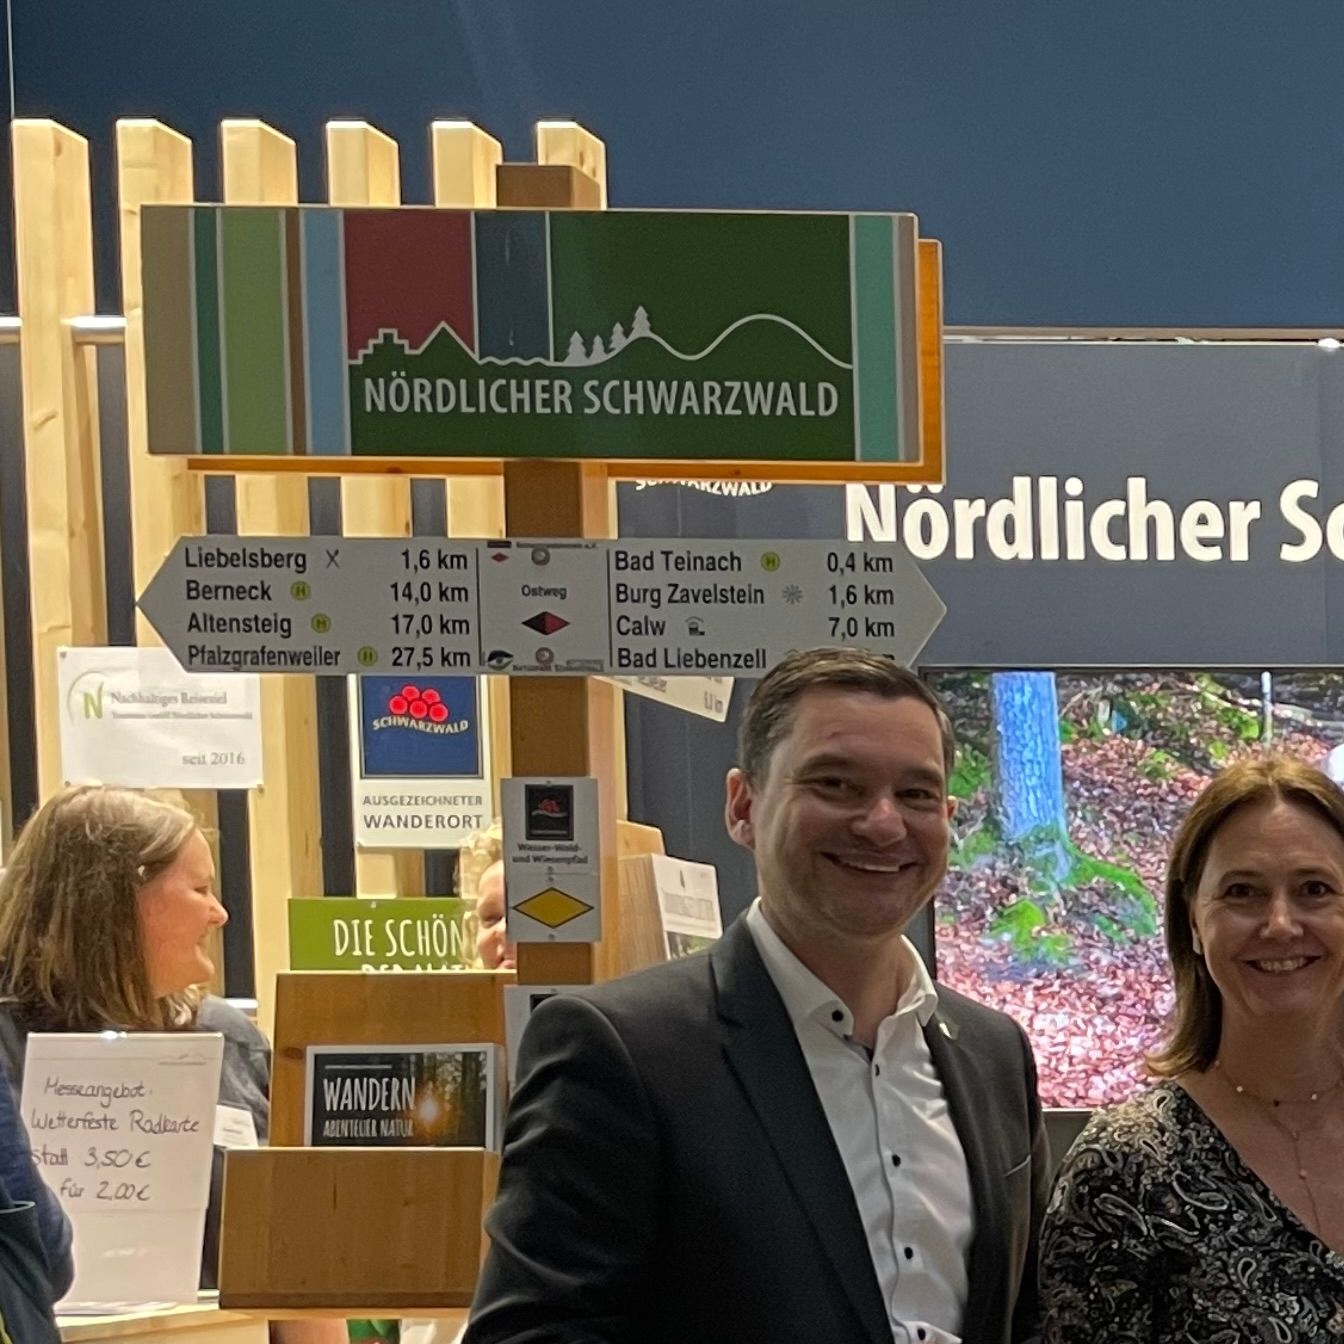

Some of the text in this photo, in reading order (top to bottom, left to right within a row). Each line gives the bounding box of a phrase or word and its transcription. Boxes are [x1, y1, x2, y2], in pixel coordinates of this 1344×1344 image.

[364, 370, 839, 417] NÖRDLICHER SCHWARZWALD
[845, 475, 1261, 561] Nördlicher
[184, 547, 468, 575] Liebelsberg 1,6 km
[615, 551, 654, 571] Bad
[660, 551, 742, 572] Teinach
[827, 552, 894, 576] 0,4 km
[186, 579, 272, 601] Berneck
[390, 581, 469, 605] 14,0 km
[521, 584, 568, 600] Ostweg
[616, 584, 764, 608] Burg Zavelstein
[829, 585, 895, 608] 1,6 km
[187, 612, 292, 638] Altensteig
[390, 614, 470, 639] 17,0 km
[616, 615, 667, 636] Calw
[828, 617, 895, 641] 7,0 km
[188, 644, 341, 671] Pfalzgrafenweiler
[391, 647, 471, 671] 27,5 km
[618, 648, 767, 669] Bad Liebenzell
[372, 715, 469, 735] SCHWARZWALD
[210, 752, 245, 765] 2016
[362, 795, 482, 807] AUSGEZEICHNETER
[363, 814, 483, 829] WANDERORT
[333, 919, 376, 956] DIE
[323, 1077, 416, 1111] WANDERN
[323, 1119, 415, 1137] ABENTEUER NATUR
